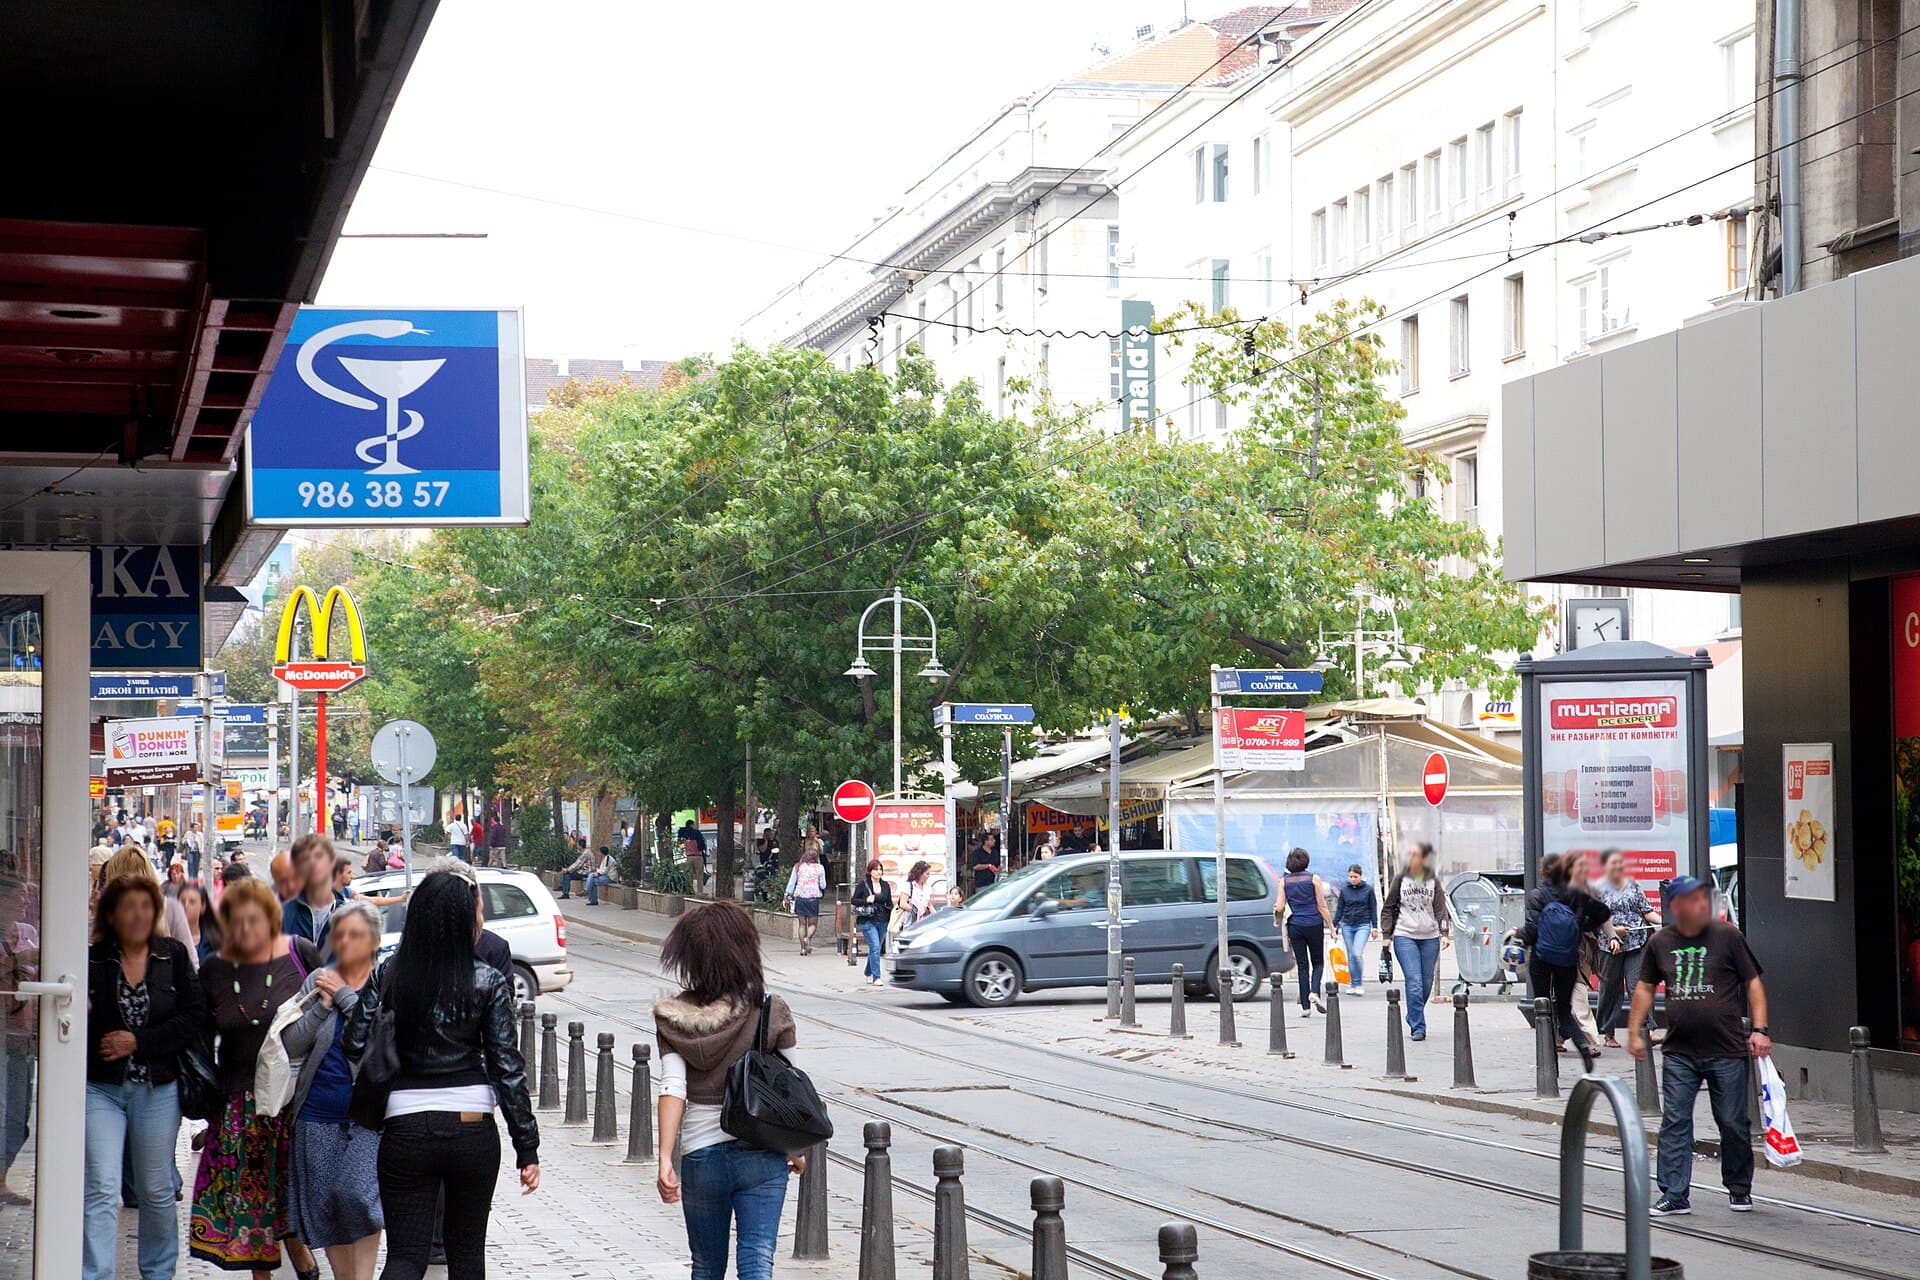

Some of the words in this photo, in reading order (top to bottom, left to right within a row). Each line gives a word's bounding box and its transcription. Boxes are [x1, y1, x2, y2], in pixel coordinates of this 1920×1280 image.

[298, 481, 354, 508] 986
[365, 481, 403, 508] 38
[413, 481, 450, 507] 57
[95, 544, 190, 599] КА
[285, 670, 356, 681] McDonald's
[127, 678, 149, 686] улица
[1250, 682, 1298, 690] СОЛУНСКА
[98, 686, 131, 695] ДЯКОН
[135, 685, 179, 695] ИГНАТИЙ
[1557, 700, 1671, 716] MULTIRAMA
[974, 713, 1014, 721] СОЛУНСКА
[1616, 714, 1658, 725] EXPERT
[1256, 718, 1281, 727] KFC
[138, 730, 189, 741] DUNKIN'
[1550, 733, 1565, 741] НИЕ
[1568, 732, 1616, 741] РАЗБИРАМЕ
[1619, 732, 1628, 740] ОТ
[1631, 731, 1678, 740] КОМПЮТРИ!
[138, 740, 188, 750] DONUTS
[1245, 738, 1300, 747] 0700-11-999
[1581, 765, 1606, 773] Голямо
[1606, 764, 1652, 773] разнообразие
[1600, 802, 1638, 810] смартфони
[911, 818, 935, 828] 0.99
[1582, 816, 1596, 824] над
[1596, 815, 1604, 823] 10
[1605, 815, 1617, 823] 000
[1619, 815, 1652, 823] аксесоара
